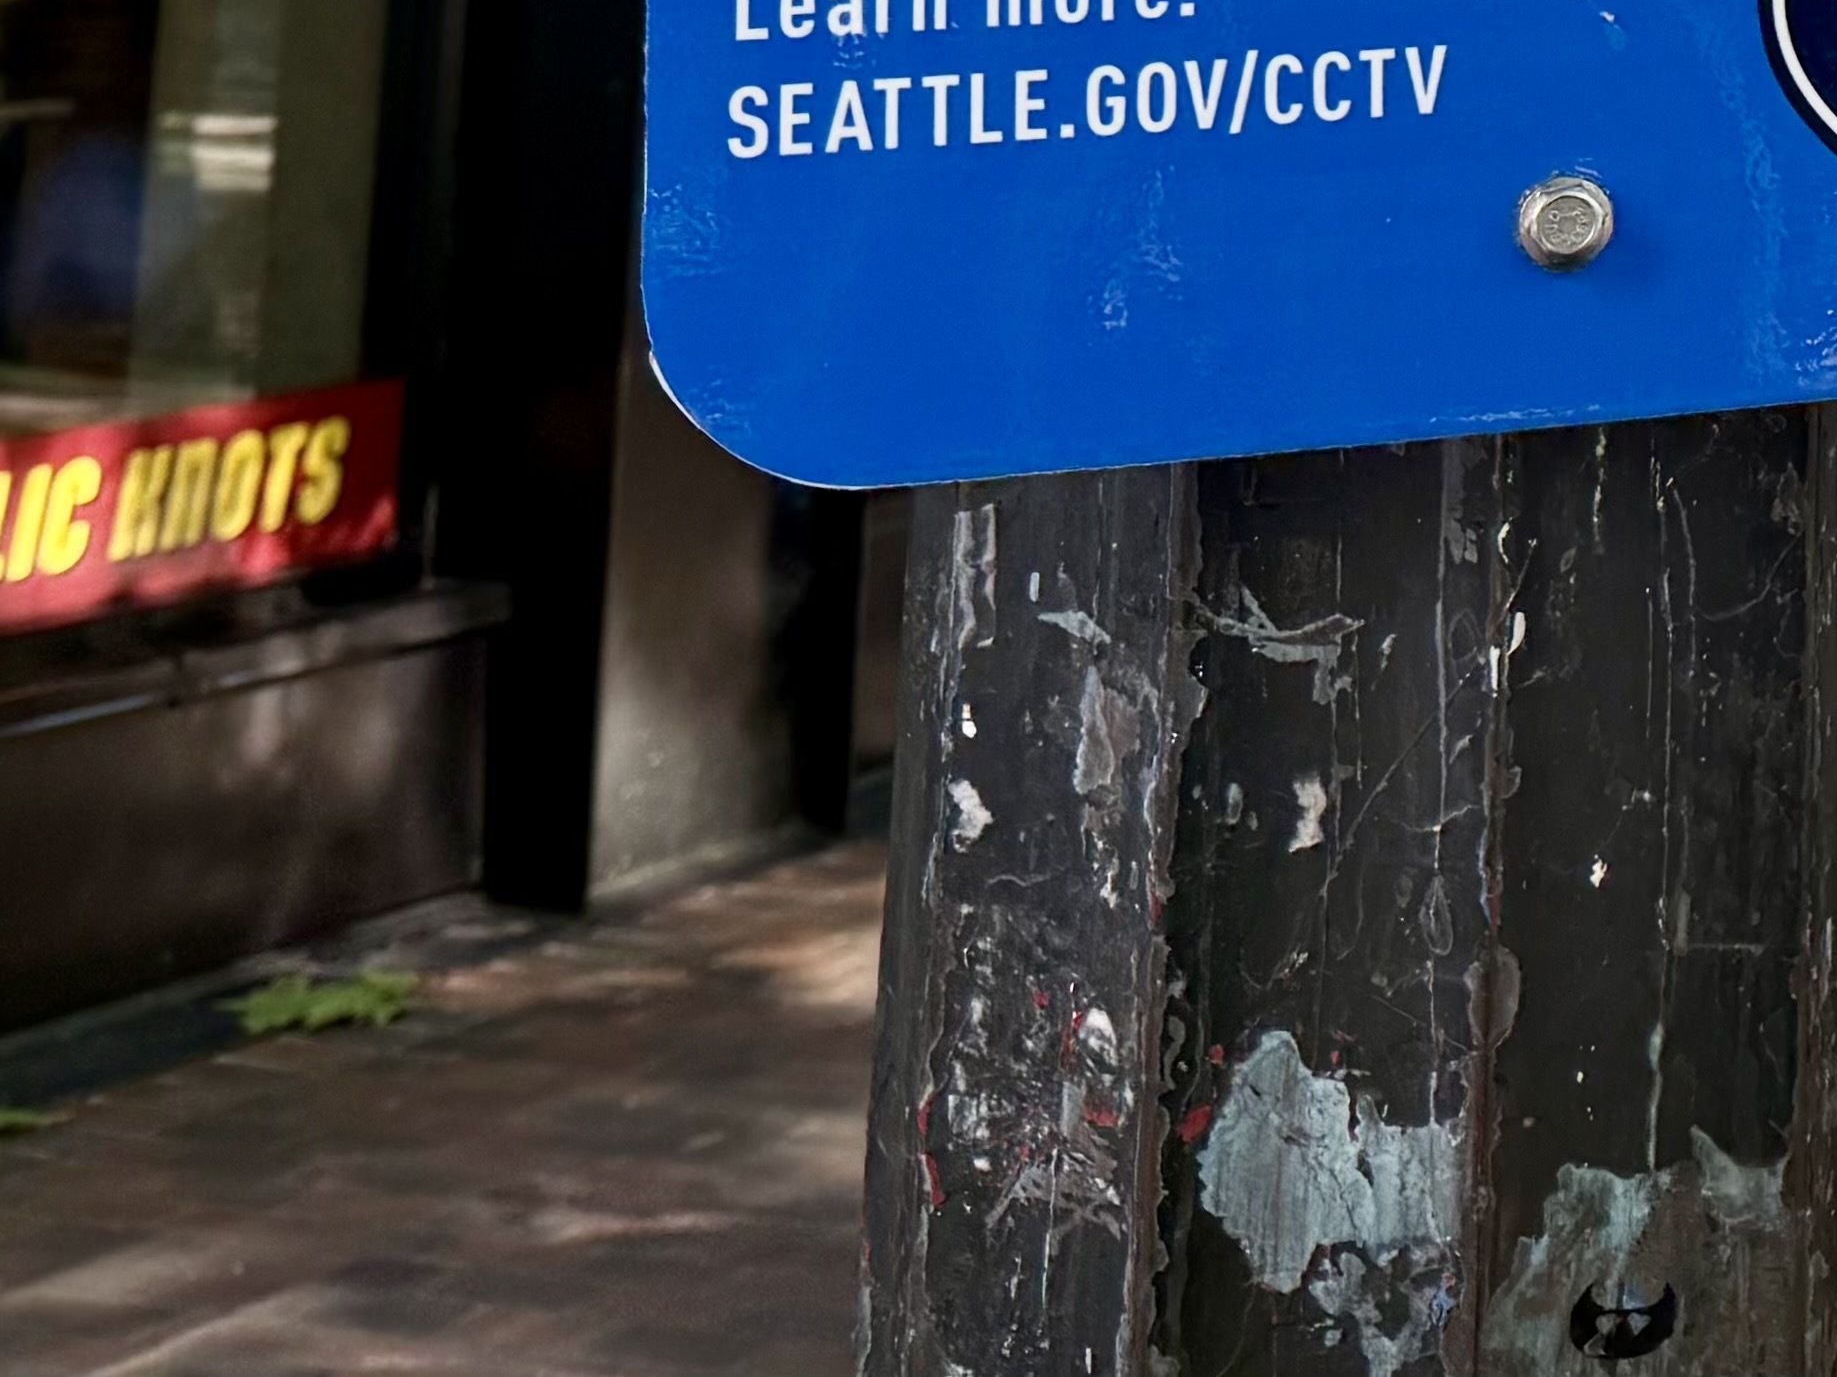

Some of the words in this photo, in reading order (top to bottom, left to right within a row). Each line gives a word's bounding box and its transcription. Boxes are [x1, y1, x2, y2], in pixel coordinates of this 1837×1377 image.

[727, 44, 1449, 160] SEATTLE.GOV/CCTV
[0, 456, 102, 583] IC
[108, 415, 352, 563] KNOTS
